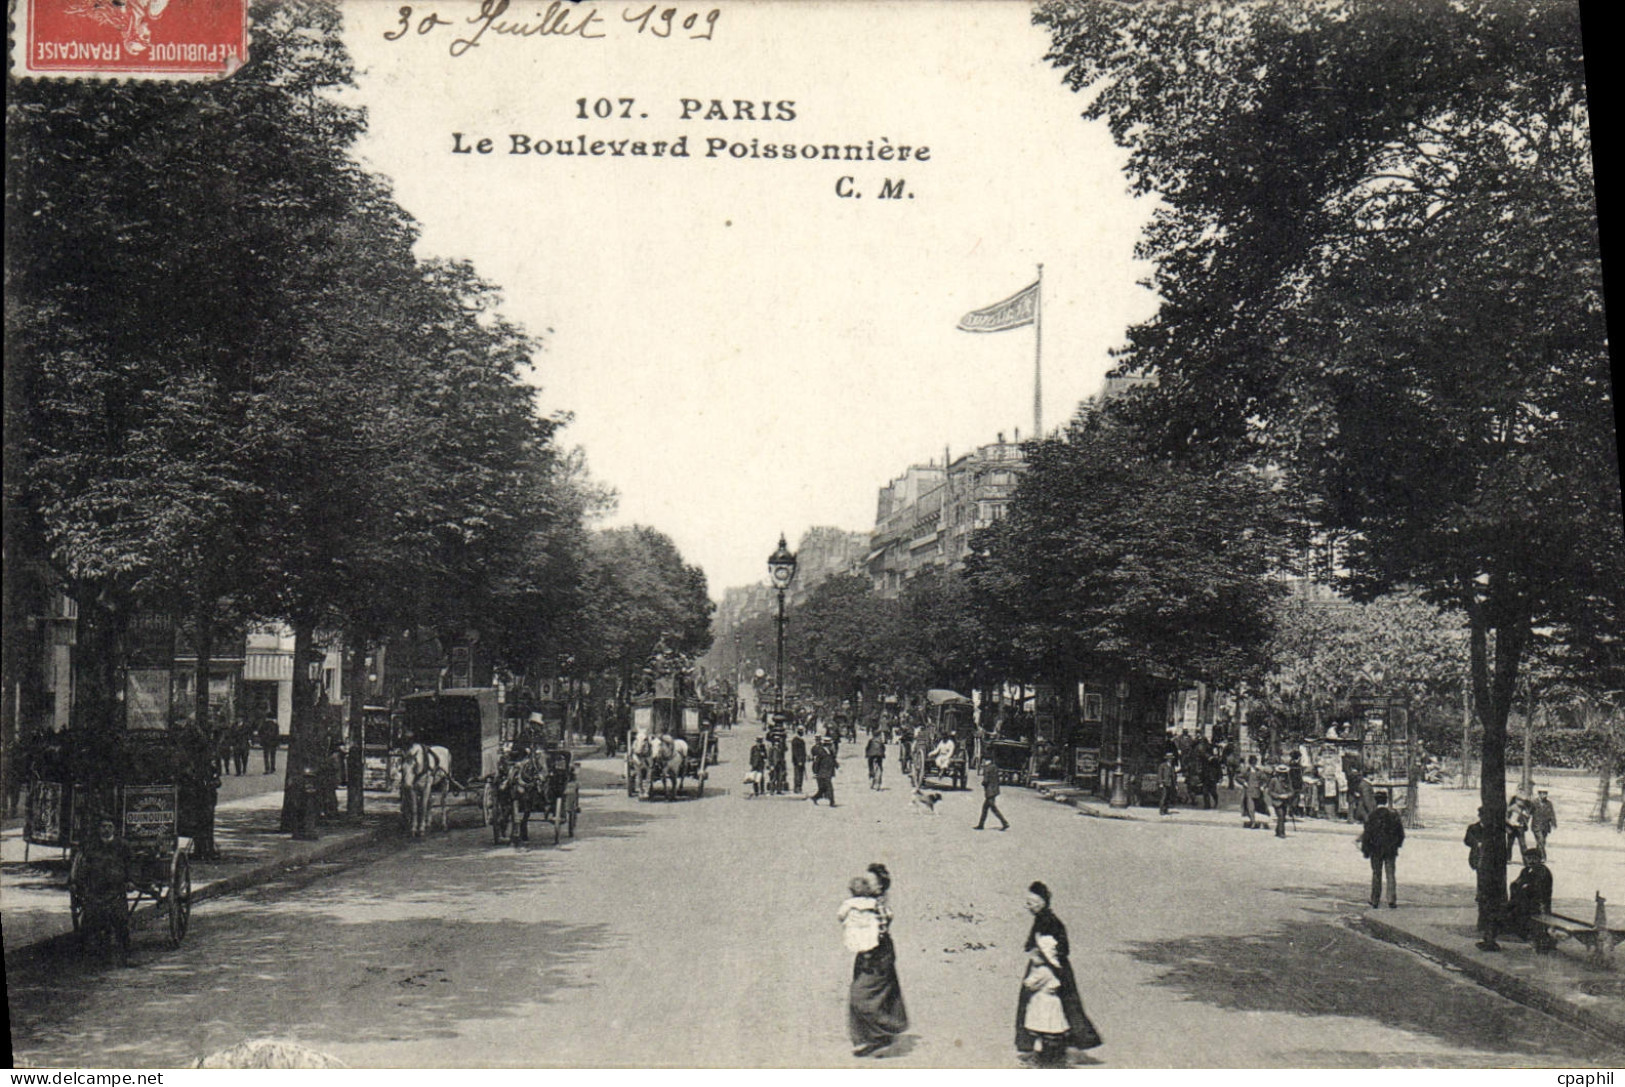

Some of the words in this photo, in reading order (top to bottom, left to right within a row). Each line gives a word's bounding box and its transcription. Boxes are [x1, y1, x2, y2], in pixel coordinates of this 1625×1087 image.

[384, 6, 452, 40] 30
[450, 0, 606, 56] Juillet
[623, 5, 720, 40] 1909
[37, 41, 121, 61] FRANÇAISE
